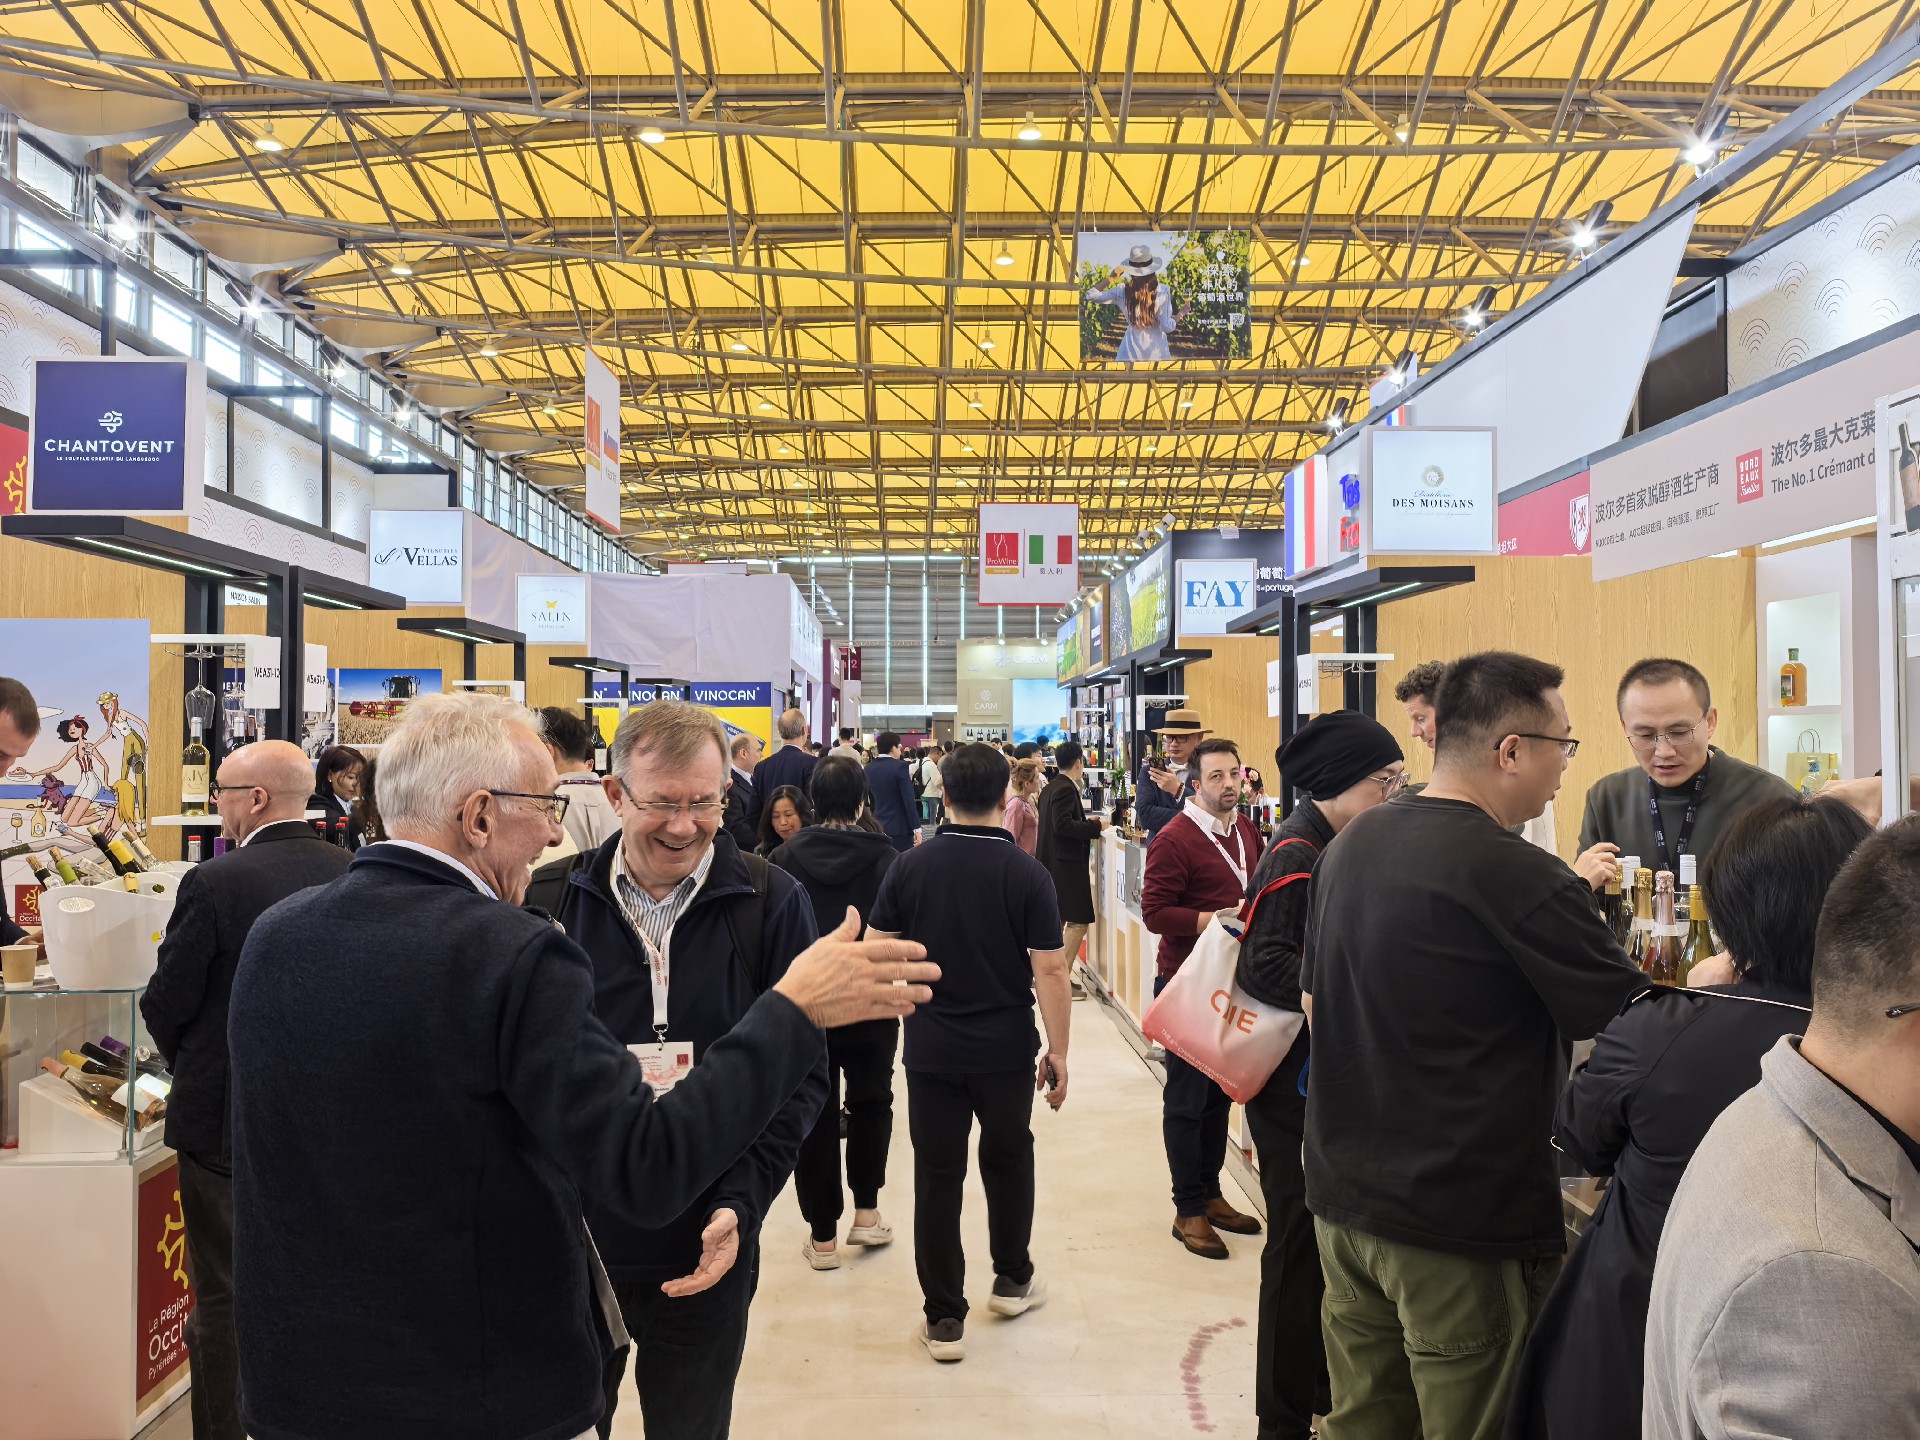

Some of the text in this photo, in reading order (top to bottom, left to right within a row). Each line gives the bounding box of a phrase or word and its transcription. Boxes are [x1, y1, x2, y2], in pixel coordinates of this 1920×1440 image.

[44, 438, 175, 453] CHANTOVENT
[1771, 477, 1790, 493] The
[1791, 467, 1815, 488] No.1
[1817, 451, 1866, 480] Crémant
[1595, 463, 1719, 523] 波尔多首家脱醇酒生产商
[1392, 499, 1474, 508] DES MOISANS
[402, 547, 458, 566] VELLAS
[1184, 580, 1252, 607] FAY
[531, 611, 571, 622] SALIN
[694, 689, 757, 701] VINOCAN
[974, 702, 998, 710] CARM
[148, 1293, 189, 1335] La Région
[148, 1348, 177, 1380] Pyrénées
